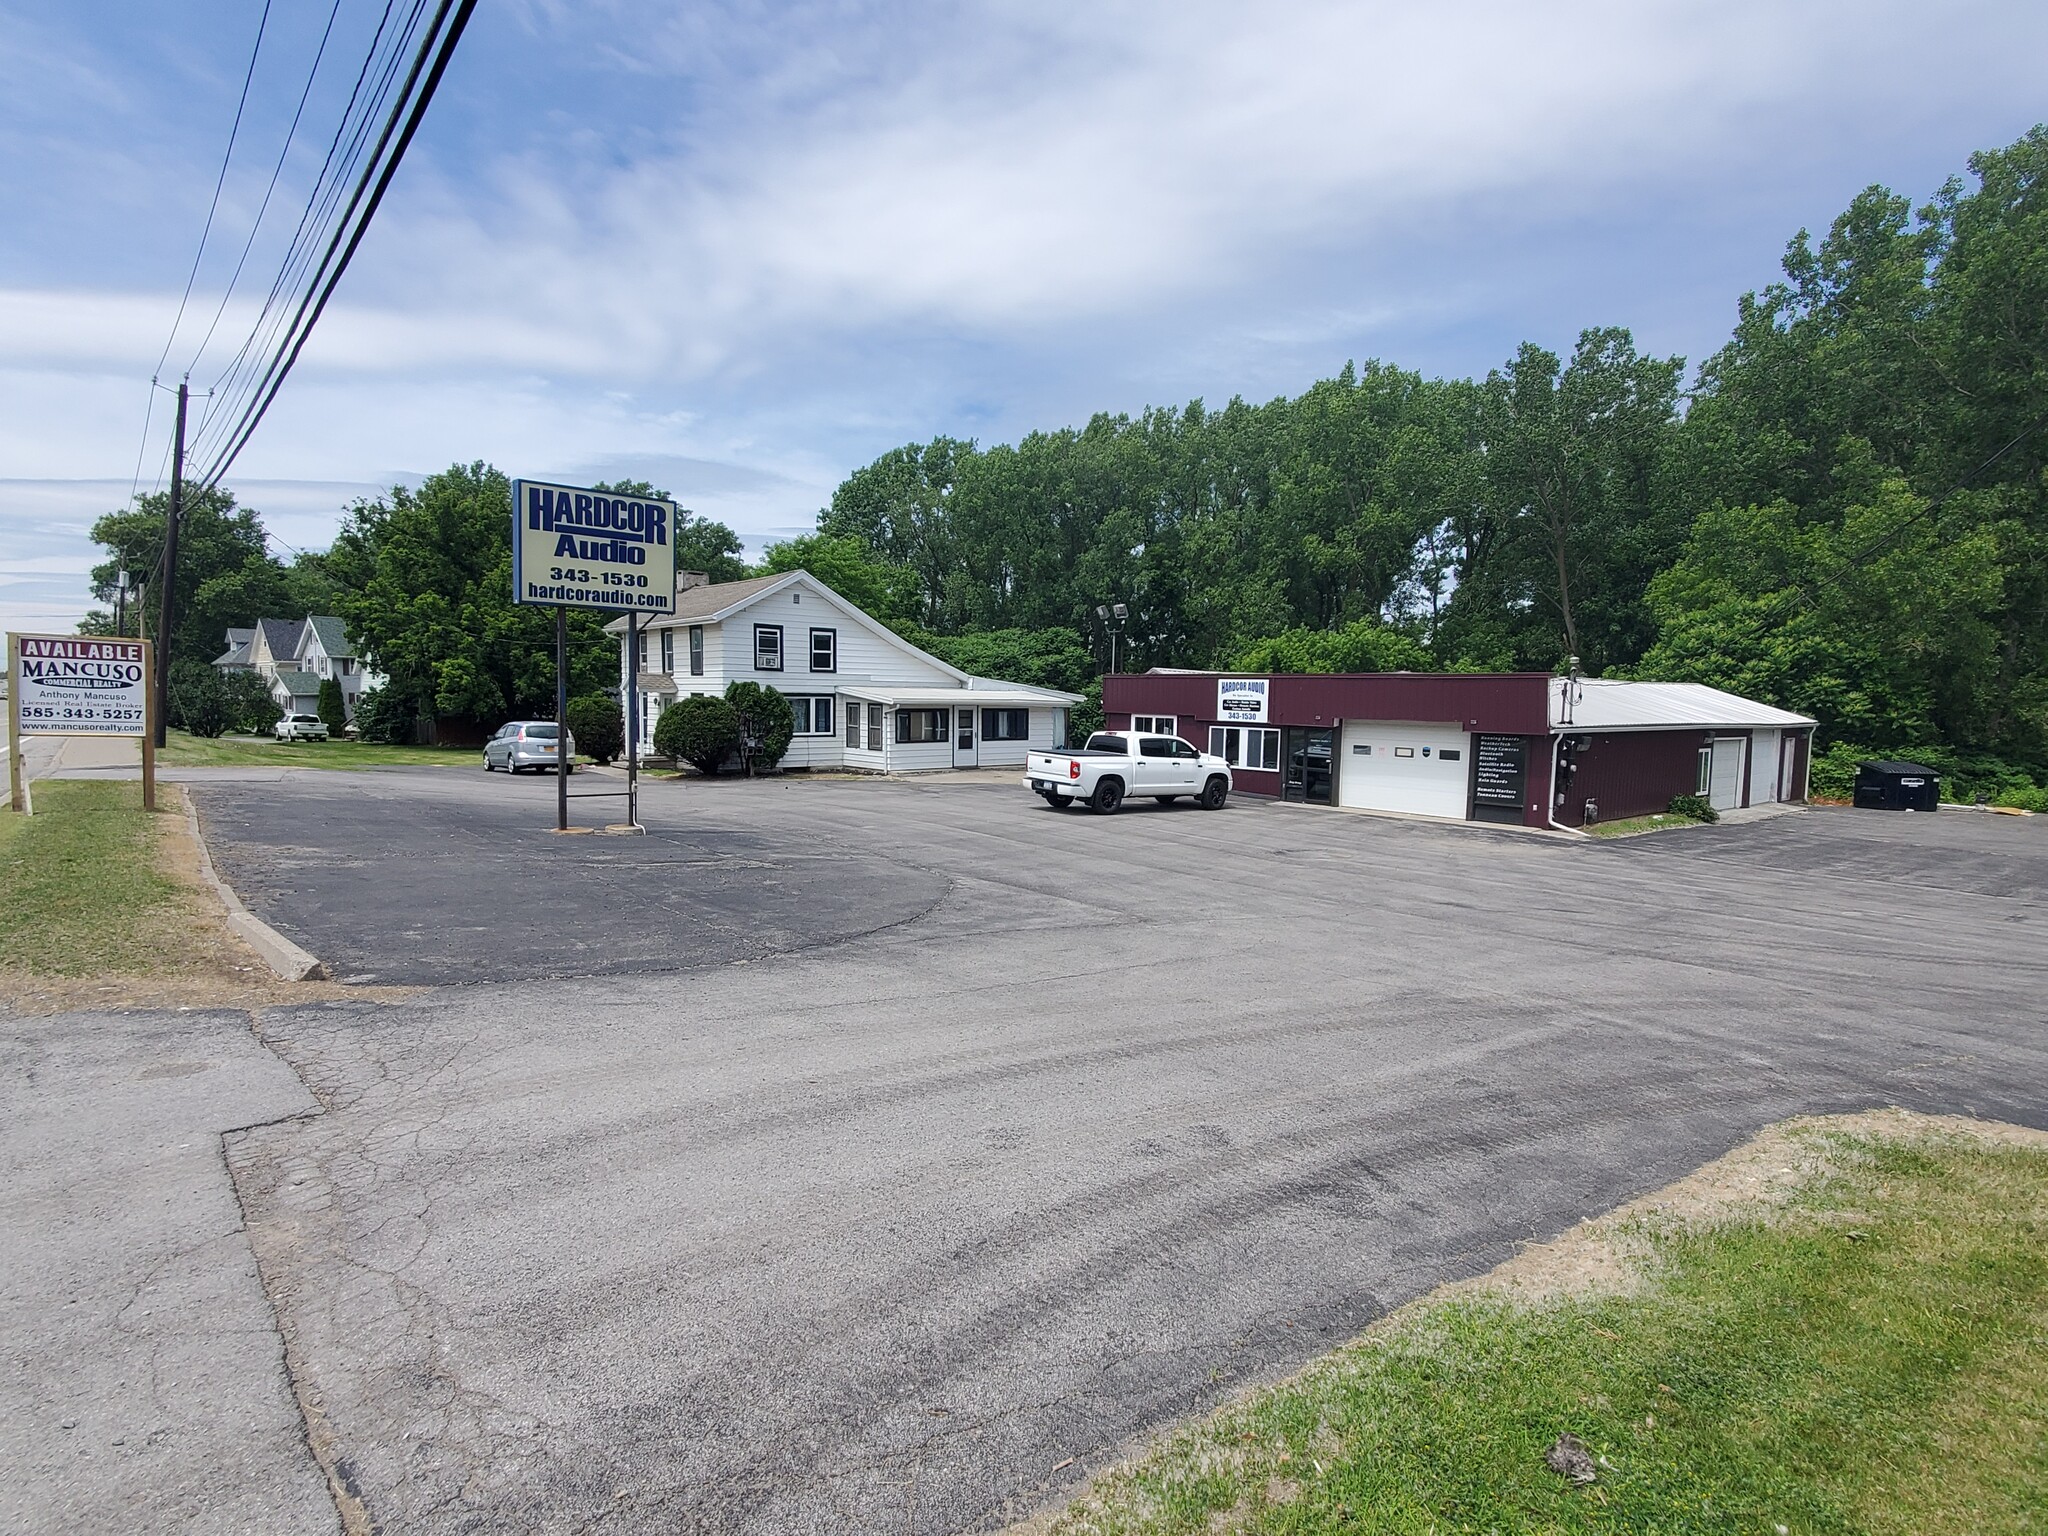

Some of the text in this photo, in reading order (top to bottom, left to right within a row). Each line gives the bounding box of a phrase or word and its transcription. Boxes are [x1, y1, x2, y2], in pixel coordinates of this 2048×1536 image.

[528, 487, 667, 546] HARDCOR
[554, 534, 646, 565] Audio
[550, 567, 649, 588] 343-1530
[528, 582, 668, 607] hardcoraudio.com
[25, 641, 139, 661] AVAILABLE
[22, 660, 142, 682] MANCUSO
[43, 679, 122, 688] COMMERCIAL REALTY
[1221, 681, 1265, 695] HARDCOR AUDIO
[39, 691, 127, 701] Anthony Mancuso
[1228, 712, 1257, 721] 343-1530
[21, 723, 144, 733] www.mancusorealty.com
